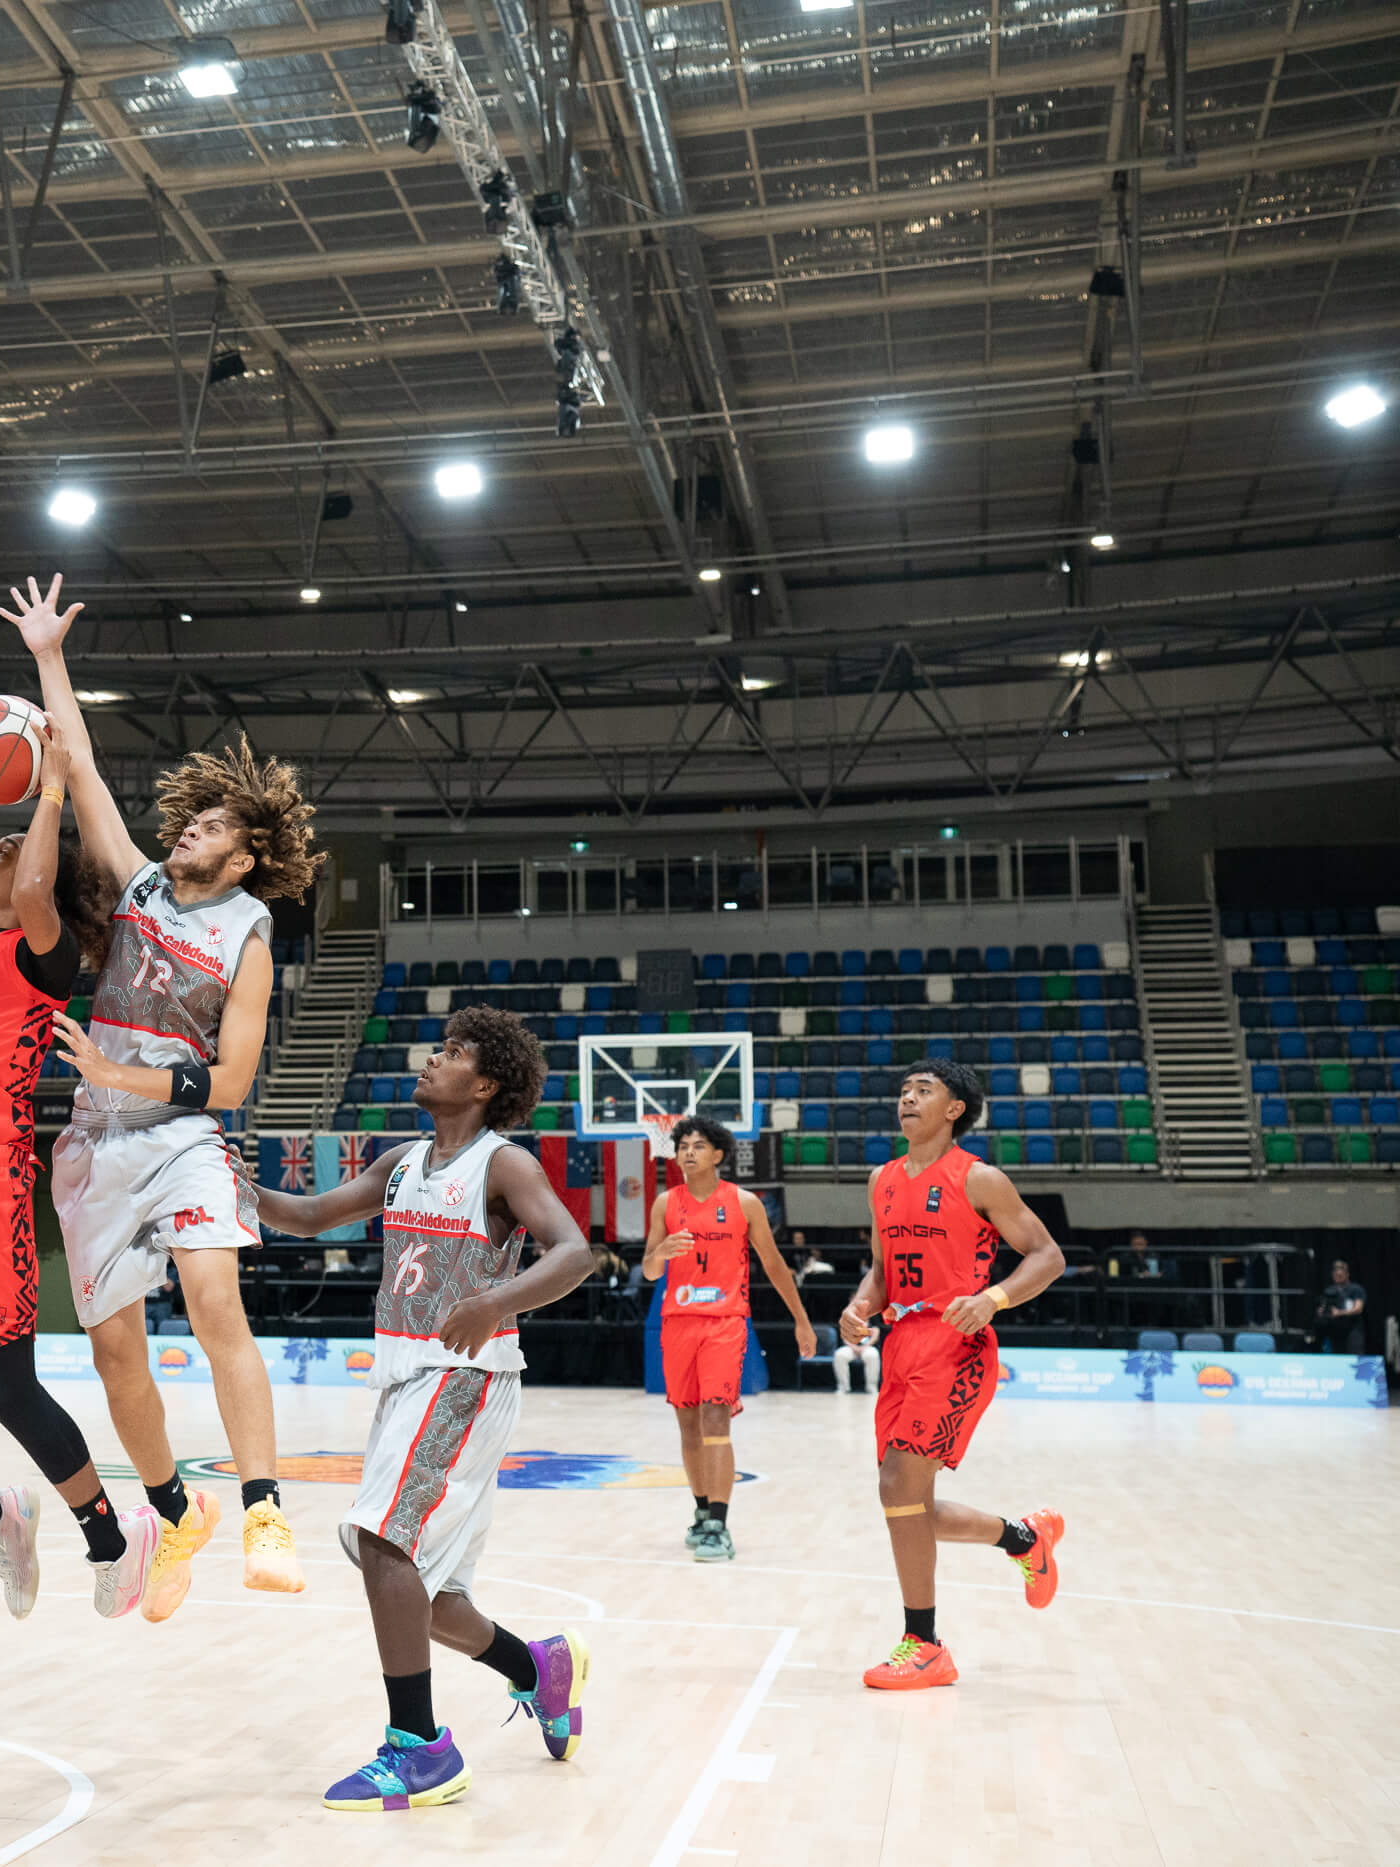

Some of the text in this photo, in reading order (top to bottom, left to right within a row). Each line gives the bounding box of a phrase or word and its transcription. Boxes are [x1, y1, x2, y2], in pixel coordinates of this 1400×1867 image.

[131, 943, 174, 996] 12
[692, 1232, 733, 1241] NGA
[882, 1224, 947, 1240] ONGA
[393, 1241, 430, 1297] 15
[696, 1251, 708, 1274] 4
